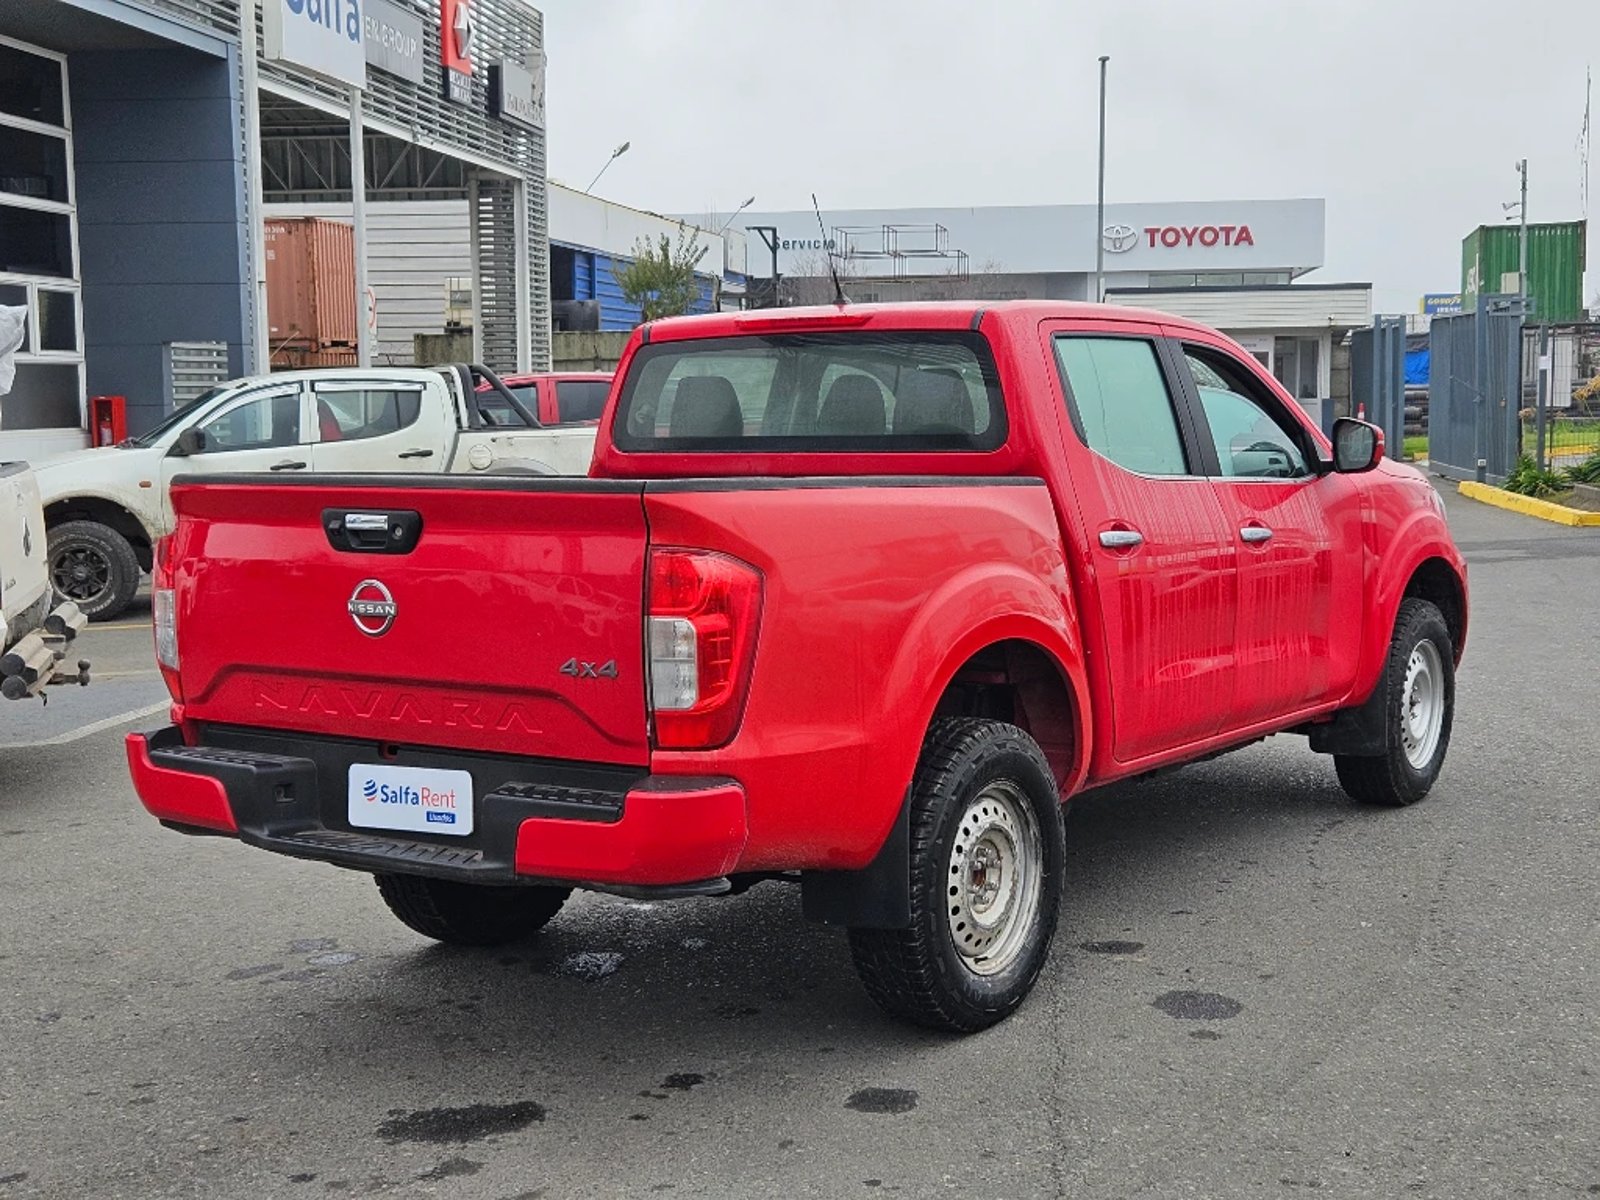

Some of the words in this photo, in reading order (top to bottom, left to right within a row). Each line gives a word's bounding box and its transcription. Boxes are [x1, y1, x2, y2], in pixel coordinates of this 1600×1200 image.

[382, 24, 417, 59] GROUP
[774, 236, 836, 250] Servicio
[1144, 225, 1254, 248] TOYOTA
[348, 602, 395, 615] NISSAN
[559, 657, 619, 679] 4x4
[251, 678, 544, 734] NAVARA
[380, 784, 457, 809] SalfaRent
